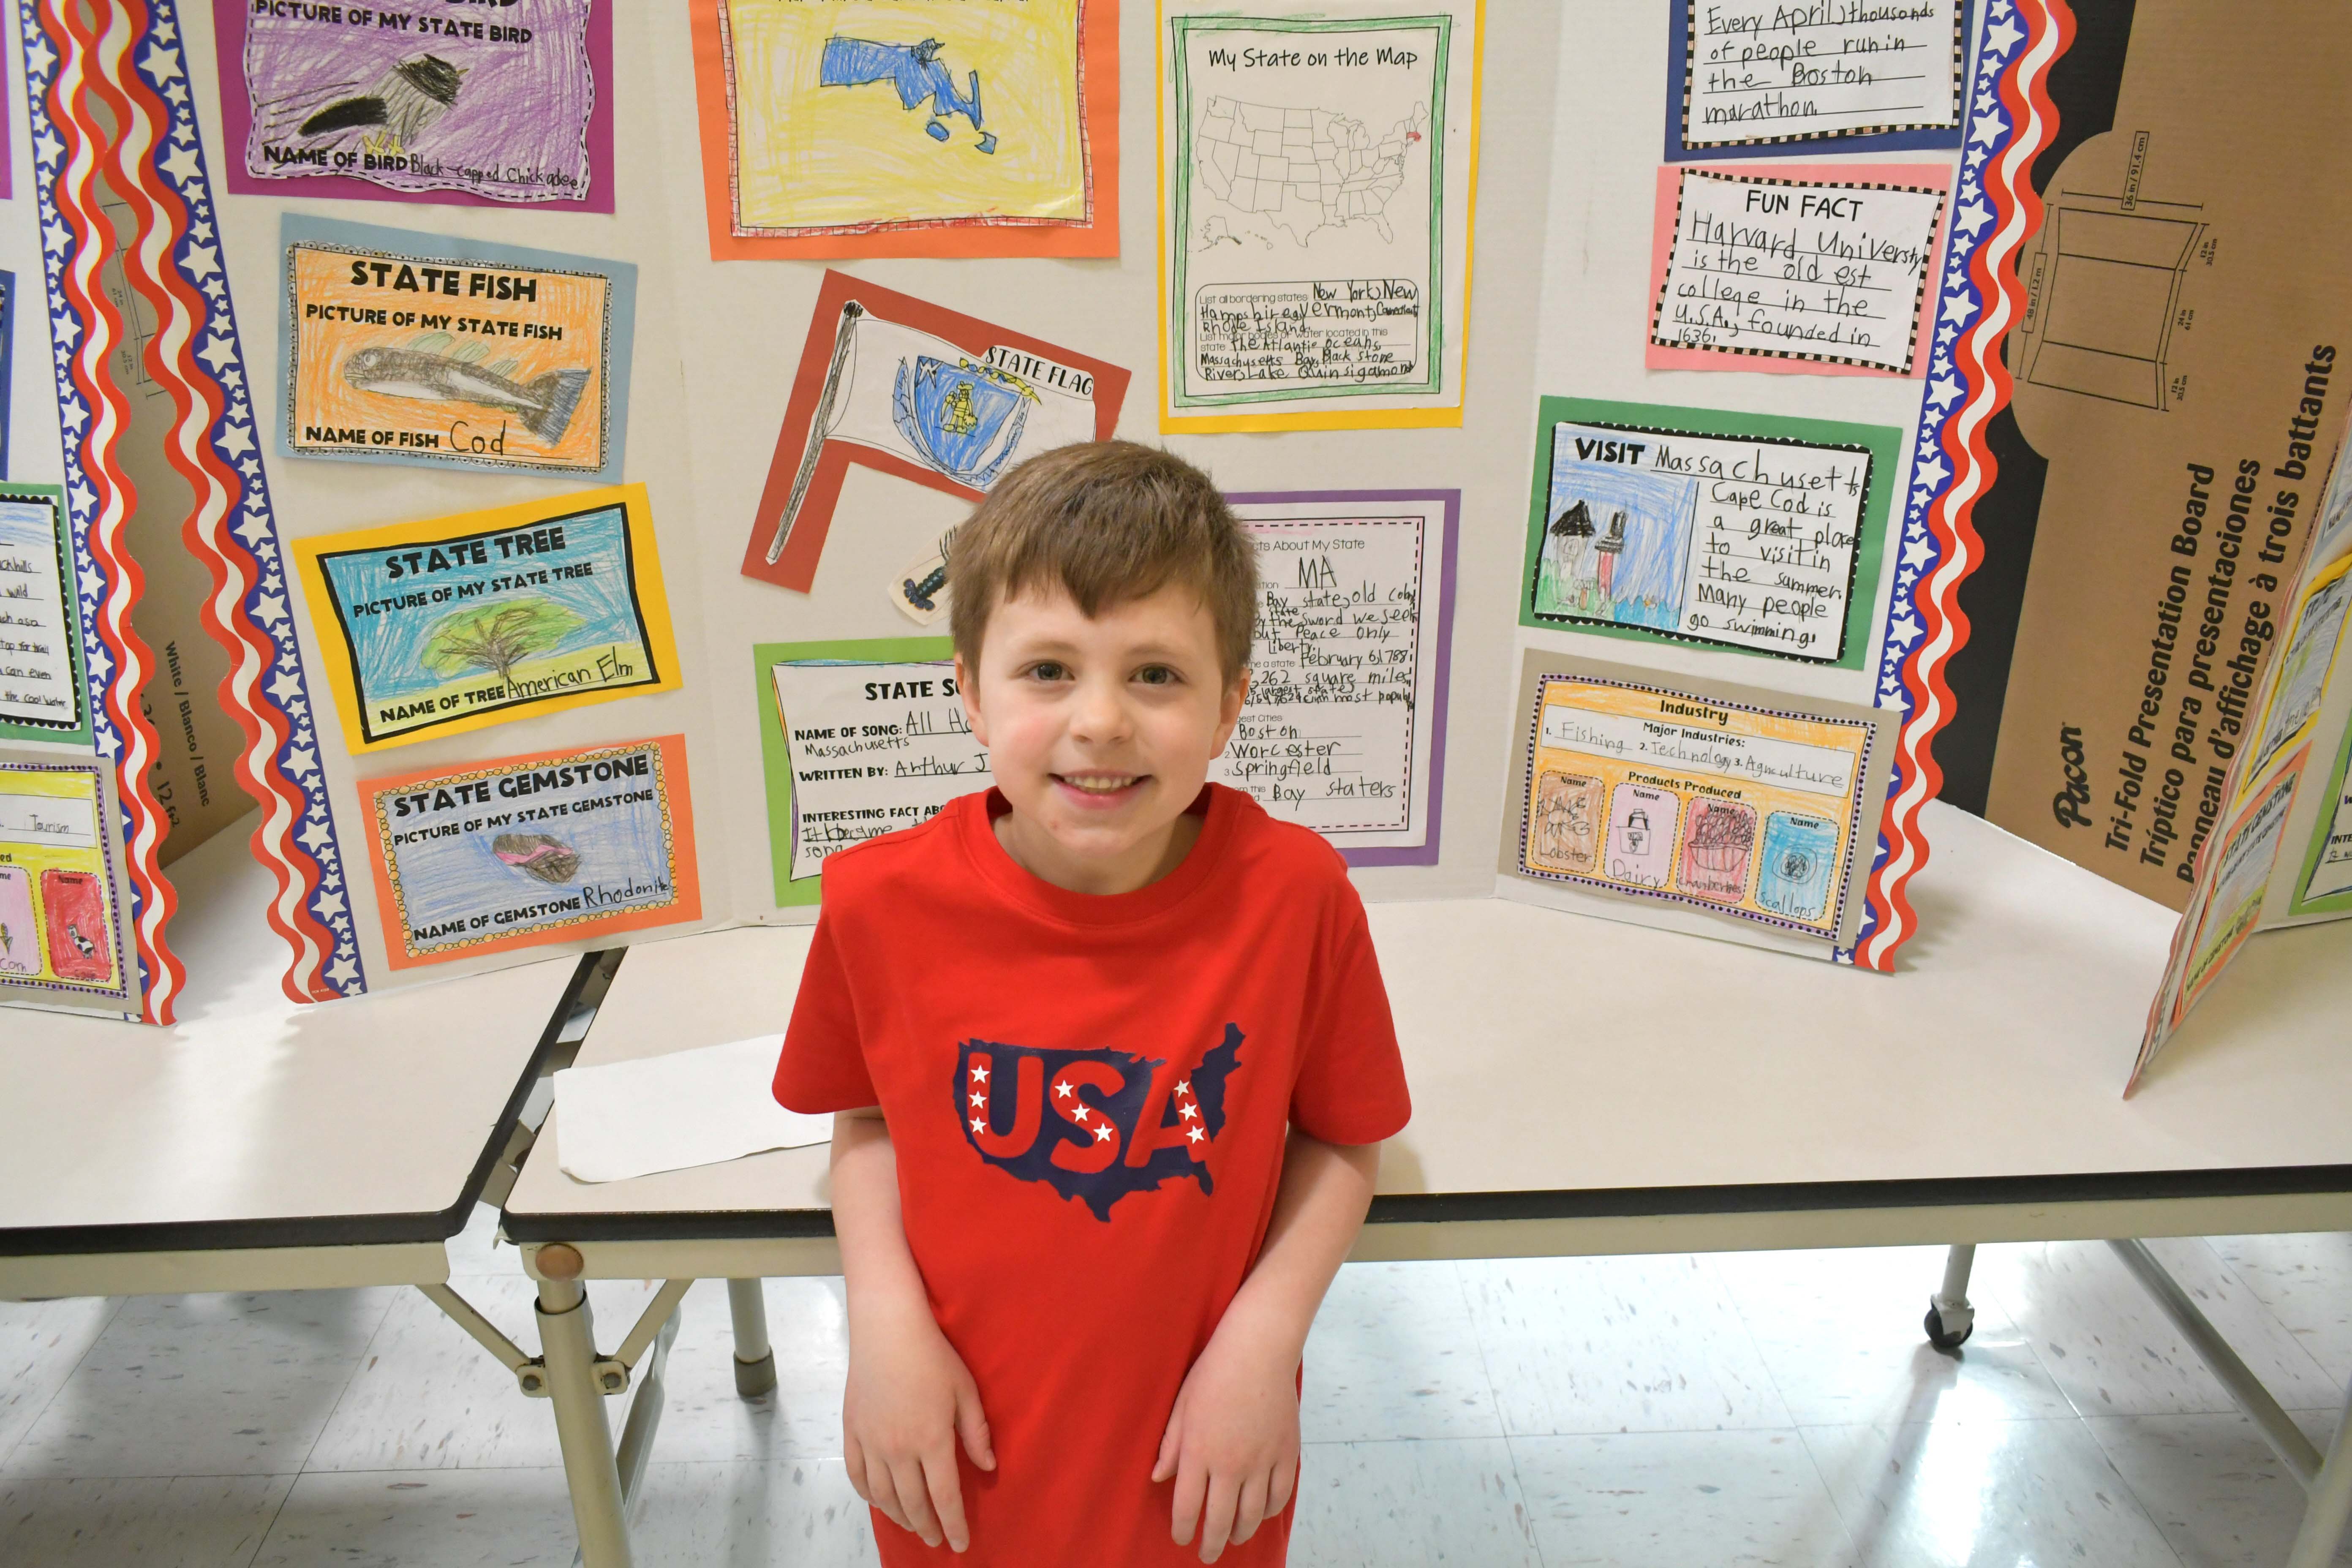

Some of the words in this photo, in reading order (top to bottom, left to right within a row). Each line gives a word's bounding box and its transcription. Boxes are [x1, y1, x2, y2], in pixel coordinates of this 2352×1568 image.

[256, 0, 342, 24] PICTURE
[348, 9, 372, 26] OF
[379, 12, 411, 30] MY
[418, 17, 483, 40] STATE
[490, 25, 533, 44] BIRD
[1707, 6, 1763, 40] Every
[1848, 1, 1935, 22] thousands
[1209, 48, 1236, 71] My
[1243, 48, 1301, 68] State
[1307, 55, 1327, 67] on
[1334, 47, 1369, 66] the
[1377, 47, 1417, 69] Map
[1711, 43, 1734, 60] of
[1742, 40, 1816, 71] people
[1709, 71, 1772, 93] the
[1792, 60, 1872, 88] Boston
[2137, 137, 2145, 152] cm
[264, 146, 327, 167] NAME
[333, 150, 357, 168] OF
[364, 153, 408, 171] BIRD
[507, 168, 578, 190] Chickadee
[2131, 155, 2142, 175] 91.4
[2125, 195, 2133, 206] 36
[2128, 185, 2136, 193] in
[1746, 189, 1789, 215] FUN
[1801, 195, 1863, 221] FACT
[1692, 210, 1796, 260] Harvard
[1693, 251, 1707, 268] is
[1718, 248, 1759, 275] the
[351, 261, 459, 296] STATE
[469, 273, 537, 302] FISH
[1677, 274, 1760, 316] college
[1785, 289, 1805, 313] in
[1824, 286, 1868, 317] the
[1200, 296, 1216, 304] List
[1219, 295, 1228, 303] all
[1230, 294, 1275, 304] bordering
[306, 304, 386, 325] PICTURE
[392, 311, 415, 327] OF
[421, 314, 452, 330] MY
[458, 318, 518, 337] STATE
[523, 323, 563, 340] FISH
[1326, 329, 1360, 337] located
[1362, 327, 1369, 337] in
[1748, 308, 1840, 343] founded
[1851, 327, 1870, 347] in
[2178, 316, 2185, 327] 24
[2185, 322, 2190, 330] 61
[2188, 310, 2194, 320] cm
[985, 346, 1045, 380] STATE
[1048, 366, 1093, 395] FLAG
[2273, 343, 2337, 480] battants
[306, 427, 365, 445] NAME
[372, 430, 394, 446] OF
[399, 432, 439, 448] FISH
[450, 420, 506, 455] Cod
[1575, 437, 1645, 465] VISIT
[1655, 445, 1861, 497] Massachusetts
[1711, 481, 1762, 511] Cape
[1771, 489, 1810, 515] Cod
[1818, 498, 1832, 517] is
[1749, 517, 1803, 540] great
[2259, 488, 2299, 567] trois
[386, 540, 487, 578] STATE
[493, 527, 566, 559] TREE
[1274, 540, 1309, 550] About
[1312, 540, 1330, 551] My
[1333, 539, 1365, 549] State
[1705, 533, 1730, 555] to
[1760, 539, 1810, 564] visit
[1812, 547, 1831, 572] in
[1298, 555, 1337, 590] MA
[1701, 556, 1751, 583] the
[2188, 457, 2261, 688] presentaciones
[2247, 572, 2278, 593] à
[354, 591, 427, 618] PICTURE
[432, 588, 453, 603] OF
[458, 581, 485, 599] MY
[492, 572, 547, 591] STATE
[552, 562, 593, 581] TREE
[1266, 591, 1288, 608] Bay
[1699, 583, 1747, 615] Many
[1763, 594, 1829, 625] people
[1301, 648, 1363, 670] February
[2105, 750, 2147, 852] Tri-Fold
[2128, 564, 2193, 748] Presentation
[2171, 463, 2215, 558] Board
[29, 668, 52, 679] even
[380, 698, 435, 722] NAME
[439, 694, 460, 710] OF
[464, 685, 506, 704] TREE
[508, 668, 591, 700] American
[596, 645, 632, 682] Elm
[865, 681, 934, 701] STATE
[165, 640, 182, 687] White
[180, 700, 196, 752] Blanco
[194, 765, 209, 806] Blanc
[1258, 714, 1282, 722] Cities
[1660, 700, 1729, 726] Industry
[795, 729, 835, 740] NAME
[841, 727, 857, 738] OF
[862, 724, 902, 736] SONG:
[1239, 724, 1301, 740] Boston
[1545, 727, 1552, 735] 1.
[1562, 721, 1627, 754] Fishing
[1640, 743, 1648, 751] 2.
[1734, 757, 1742, 767] 3.
[1643, 721, 1677, 738] Major
[1681, 728, 1746, 748] Industries:
[2171, 694, 2206, 765] para
[805, 737, 910, 758] Massachusetts
[1230, 740, 1341, 759] Worcester
[799, 768, 862, 781] WRITTEN
[868, 767, 888, 776] BY:
[896, 756, 965, 776] Arthur
[1560, 776, 1587, 788] Name
[2052, 725, 2092, 828] Pacon
[395, 781, 491, 817] STATE
[498, 754, 649, 799] GEMSTONE
[1273, 783, 1305, 811] Bay
[1628, 771, 1681, 790] Products
[1684, 781, 1742, 799] Produced
[1633, 789, 1660, 802] Name
[30, 814, 69, 833] Tourism
[394, 822, 460, 846] PICTURE
[464, 818, 482, 832] OF
[487, 814, 512, 828] MY
[518, 803, 568, 823] STATE
[572, 789, 653, 813] GEMSTONE
[803, 808, 885, 823] INTERESTING
[890, 807, 919, 817] FACT
[1790, 817, 1819, 830] Name
[2140, 767, 2184, 869] Tríptico
[2176, 765, 2227, 884] Panneau
[1612, 859, 1660, 889] Dairy
[414, 920, 466, 941] NAME
[470, 915, 490, 929] OF
[494, 897, 580, 925] GEMSTONE
[967, 1052, 1213, 1174] USA
